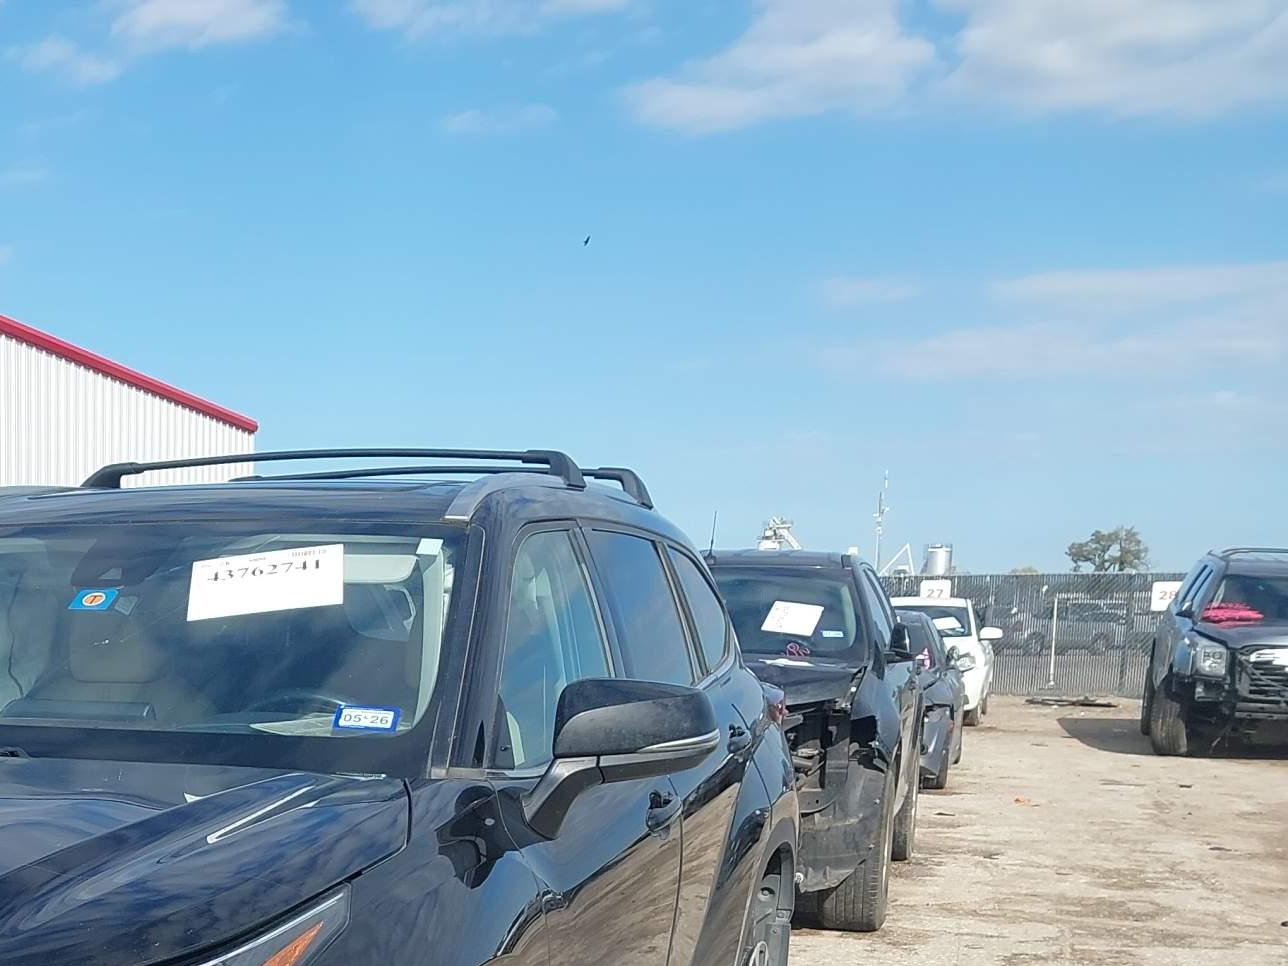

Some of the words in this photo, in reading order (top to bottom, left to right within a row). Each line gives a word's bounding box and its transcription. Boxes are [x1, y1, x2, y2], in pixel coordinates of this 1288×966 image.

[207, 559, 321, 582] 43762741
[926, 588, 944, 599] 27
[343, 713, 362, 723] 05
[369, 715, 390, 725] 26
